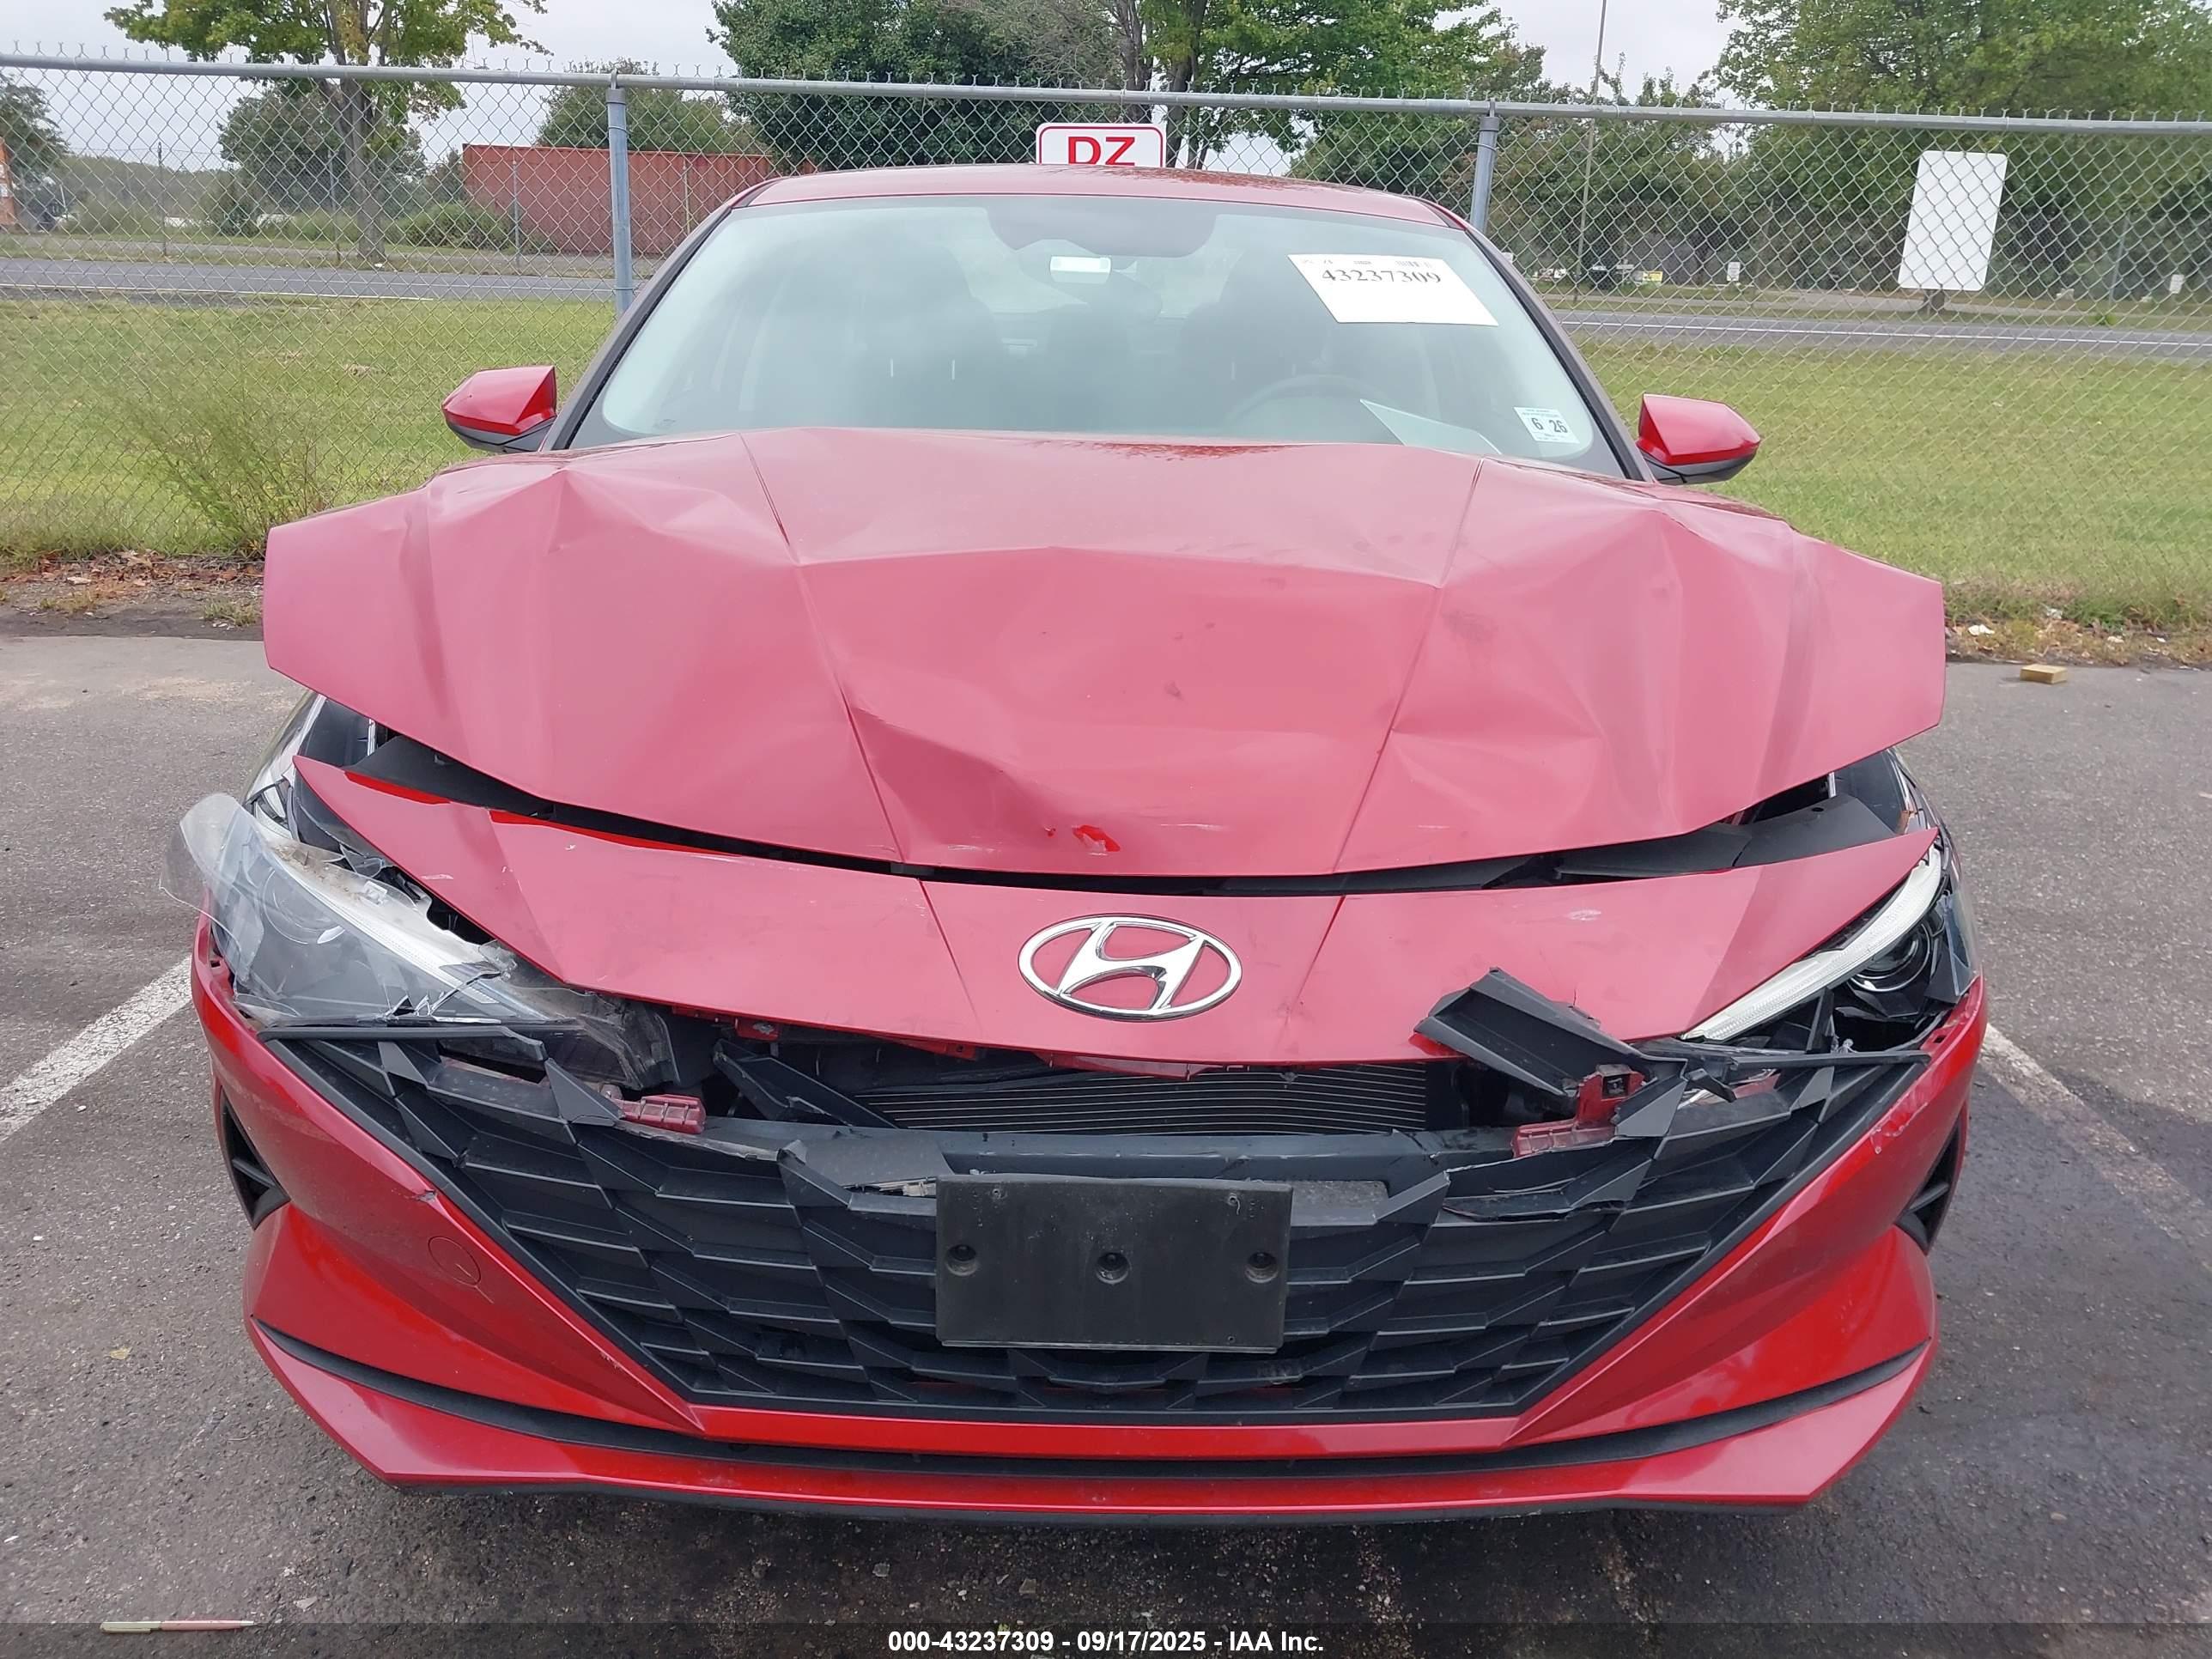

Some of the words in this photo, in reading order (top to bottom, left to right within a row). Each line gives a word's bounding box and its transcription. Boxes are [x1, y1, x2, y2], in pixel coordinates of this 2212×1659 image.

[1067, 136, 1135, 166] DZ
[1322, 269, 1442, 283] 43237309
[1531, 417, 1544, 430] 6
[1548, 419, 1568, 434] 26
